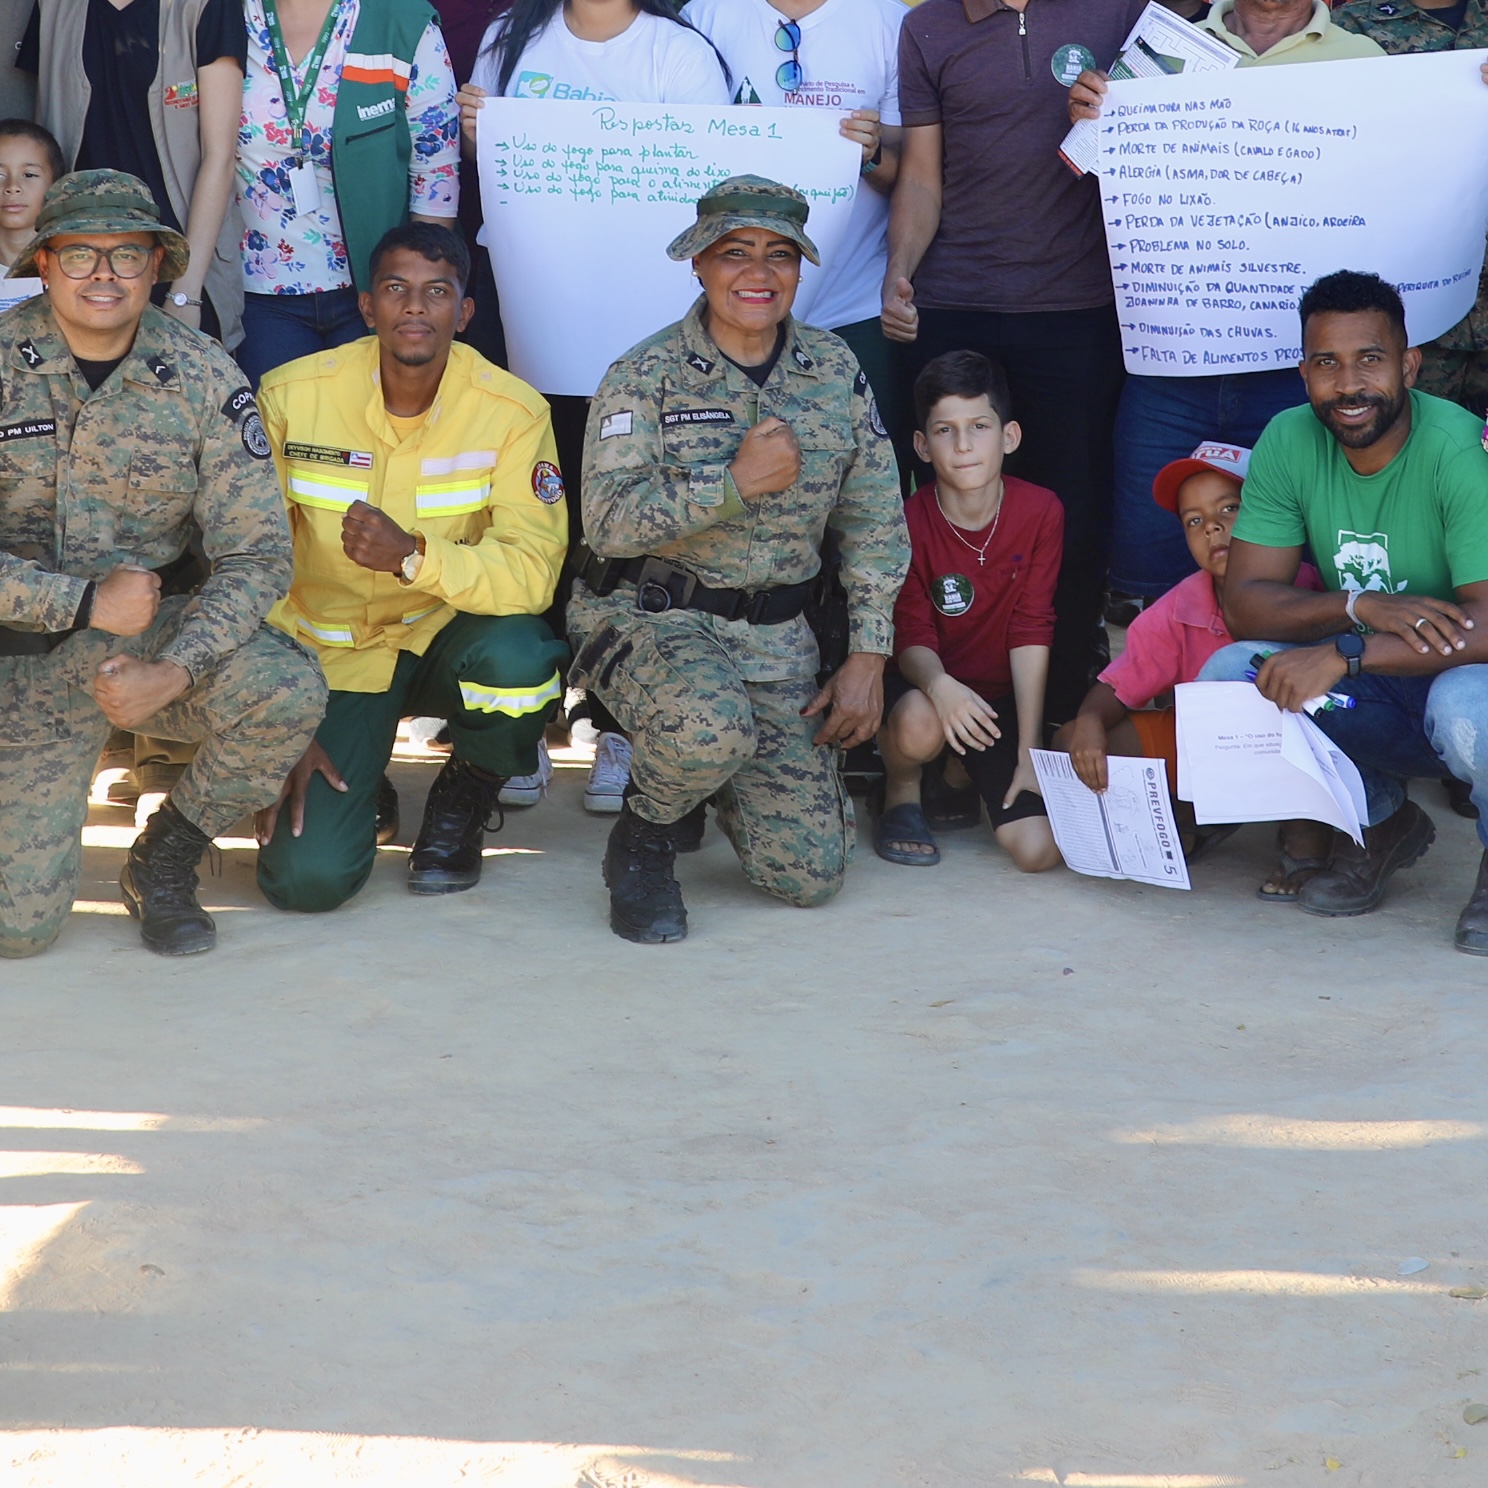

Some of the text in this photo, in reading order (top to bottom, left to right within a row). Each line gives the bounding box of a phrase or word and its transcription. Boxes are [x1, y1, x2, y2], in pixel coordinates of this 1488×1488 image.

[553, 83, 616, 102] Bahi
[824, 81, 851, 89] Pesquisa
[784, 93, 842, 106] MANEJO
[1117, 98, 1232, 117] QUEIMADURA NAS MÃO
[592, 106, 782, 139] Respostas Mesa 1
[1117, 121, 1150, 136] PERDA
[1155, 121, 1168, 131] DA
[1172, 117, 1227, 131] PRODUÇÃO
[1232, 120, 1245, 130] DA
[1248, 118, 1281, 133] ROÇA
[1285, 120, 1300, 134] (16
[1303, 124, 1324, 135] ANOS
[513, 133, 699, 163] Uso do fogo para plantar
[1119, 140, 1321, 161] MORTE DE ANIMAIS (CAVALO E GADO)
[513, 154, 731, 183] Uso do fogo para queima do lixo
[1119, 164, 1162, 179] ALERGIA
[1234, 170, 1248, 180] DE
[1253, 170, 1303, 185] CABEÇA)
[545, 171, 562, 182] do
[569, 174, 600, 191] fogo
[611, 176, 640, 192] para
[648, 179, 655, 188] o
[662, 178, 719, 190] aliment
[547, 184, 563, 195] do
[569, 186, 602, 203] fogo
[611, 187, 640, 205] para
[647, 190, 701, 204] ativida
[1122, 193, 1216, 207] FOGO NO LIXÃO.
[1125, 214, 1165, 230] PERDA
[1170, 216, 1184, 227] DA
[1323, 214, 1366, 227] AROEIRA
[1129, 240, 1250, 253] PROBLEMA NO SOLO.
[1131, 260, 1306, 275] MORTE DE ANIMAIS SILVESTRE.
[1132, 280, 1200, 295] DIMINUIÇÃO
[1206, 283, 1221, 292] DA
[1225, 281, 1295, 294] QUANTIDADE
[1397, 280, 1439, 293] PERIQUITA
[1186, 298, 1197, 308] DE
[1202, 298, 1246, 311] BARRO,
[1139, 323, 1277, 338] DIMINUIÇÃO DAS CHUVAS.
[1141, 346, 1177, 363] FALTA
[1183, 350, 1197, 364] DE
[1203, 350, 1268, 365] ALIMENTOS
[664, 410, 731, 424] SGT PM ELISÂNGELA
[7, 428, 22, 437] PM
[24, 424, 54, 434] UILTON
[289, 450, 309, 459] CHEFE
[319, 454, 344, 463] BRIGADA
[1266, 741, 1281, 749] situaç
[1146, 781, 1171, 848] PREVFOGO
[1163, 864, 1178, 875] 5
